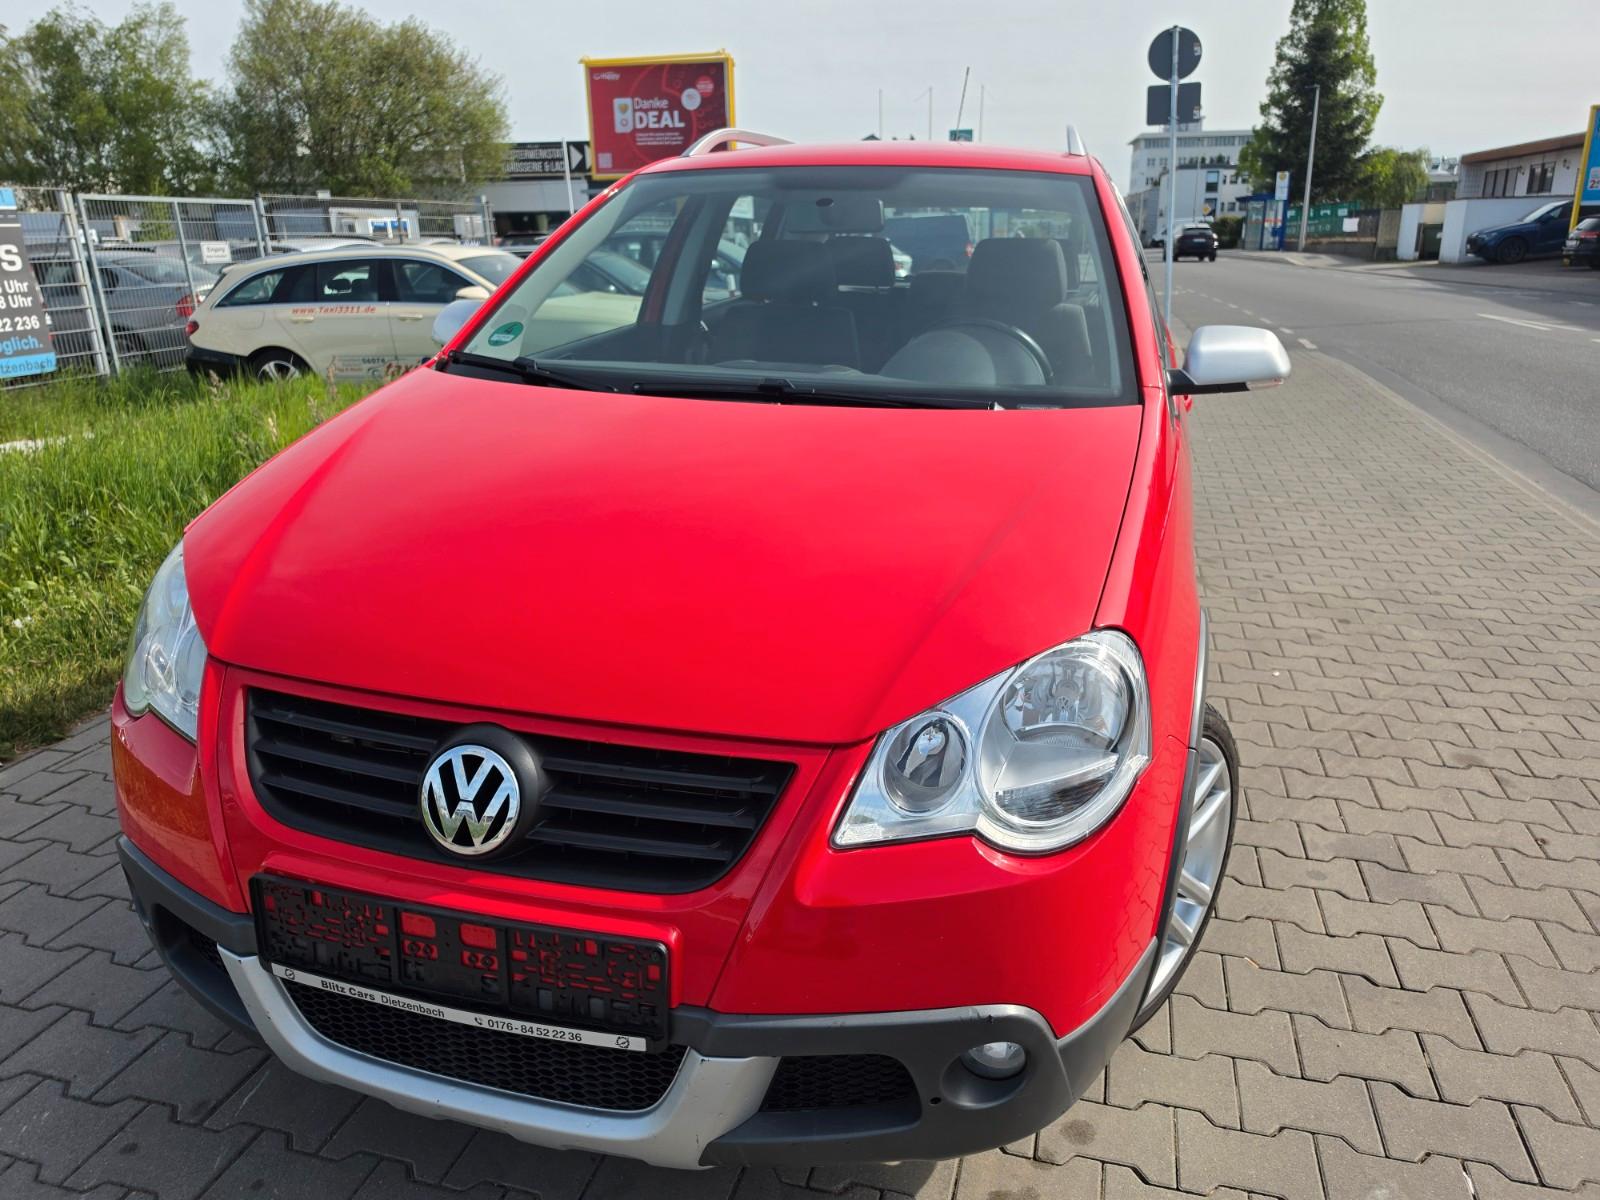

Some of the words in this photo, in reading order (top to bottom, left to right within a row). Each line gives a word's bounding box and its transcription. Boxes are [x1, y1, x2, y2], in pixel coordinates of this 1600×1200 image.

[635, 110, 686, 129] DEAL
[4, 279, 29, 294] Uhr
[8, 294, 33, 309] Uhr
[14, 315, 40, 331] 236
[0, 335, 44, 356] glich.
[320, 979, 347, 994] Blitz
[348, 987, 376, 1001] Cars
[381, 994, 445, 1018] Dietzenbach
